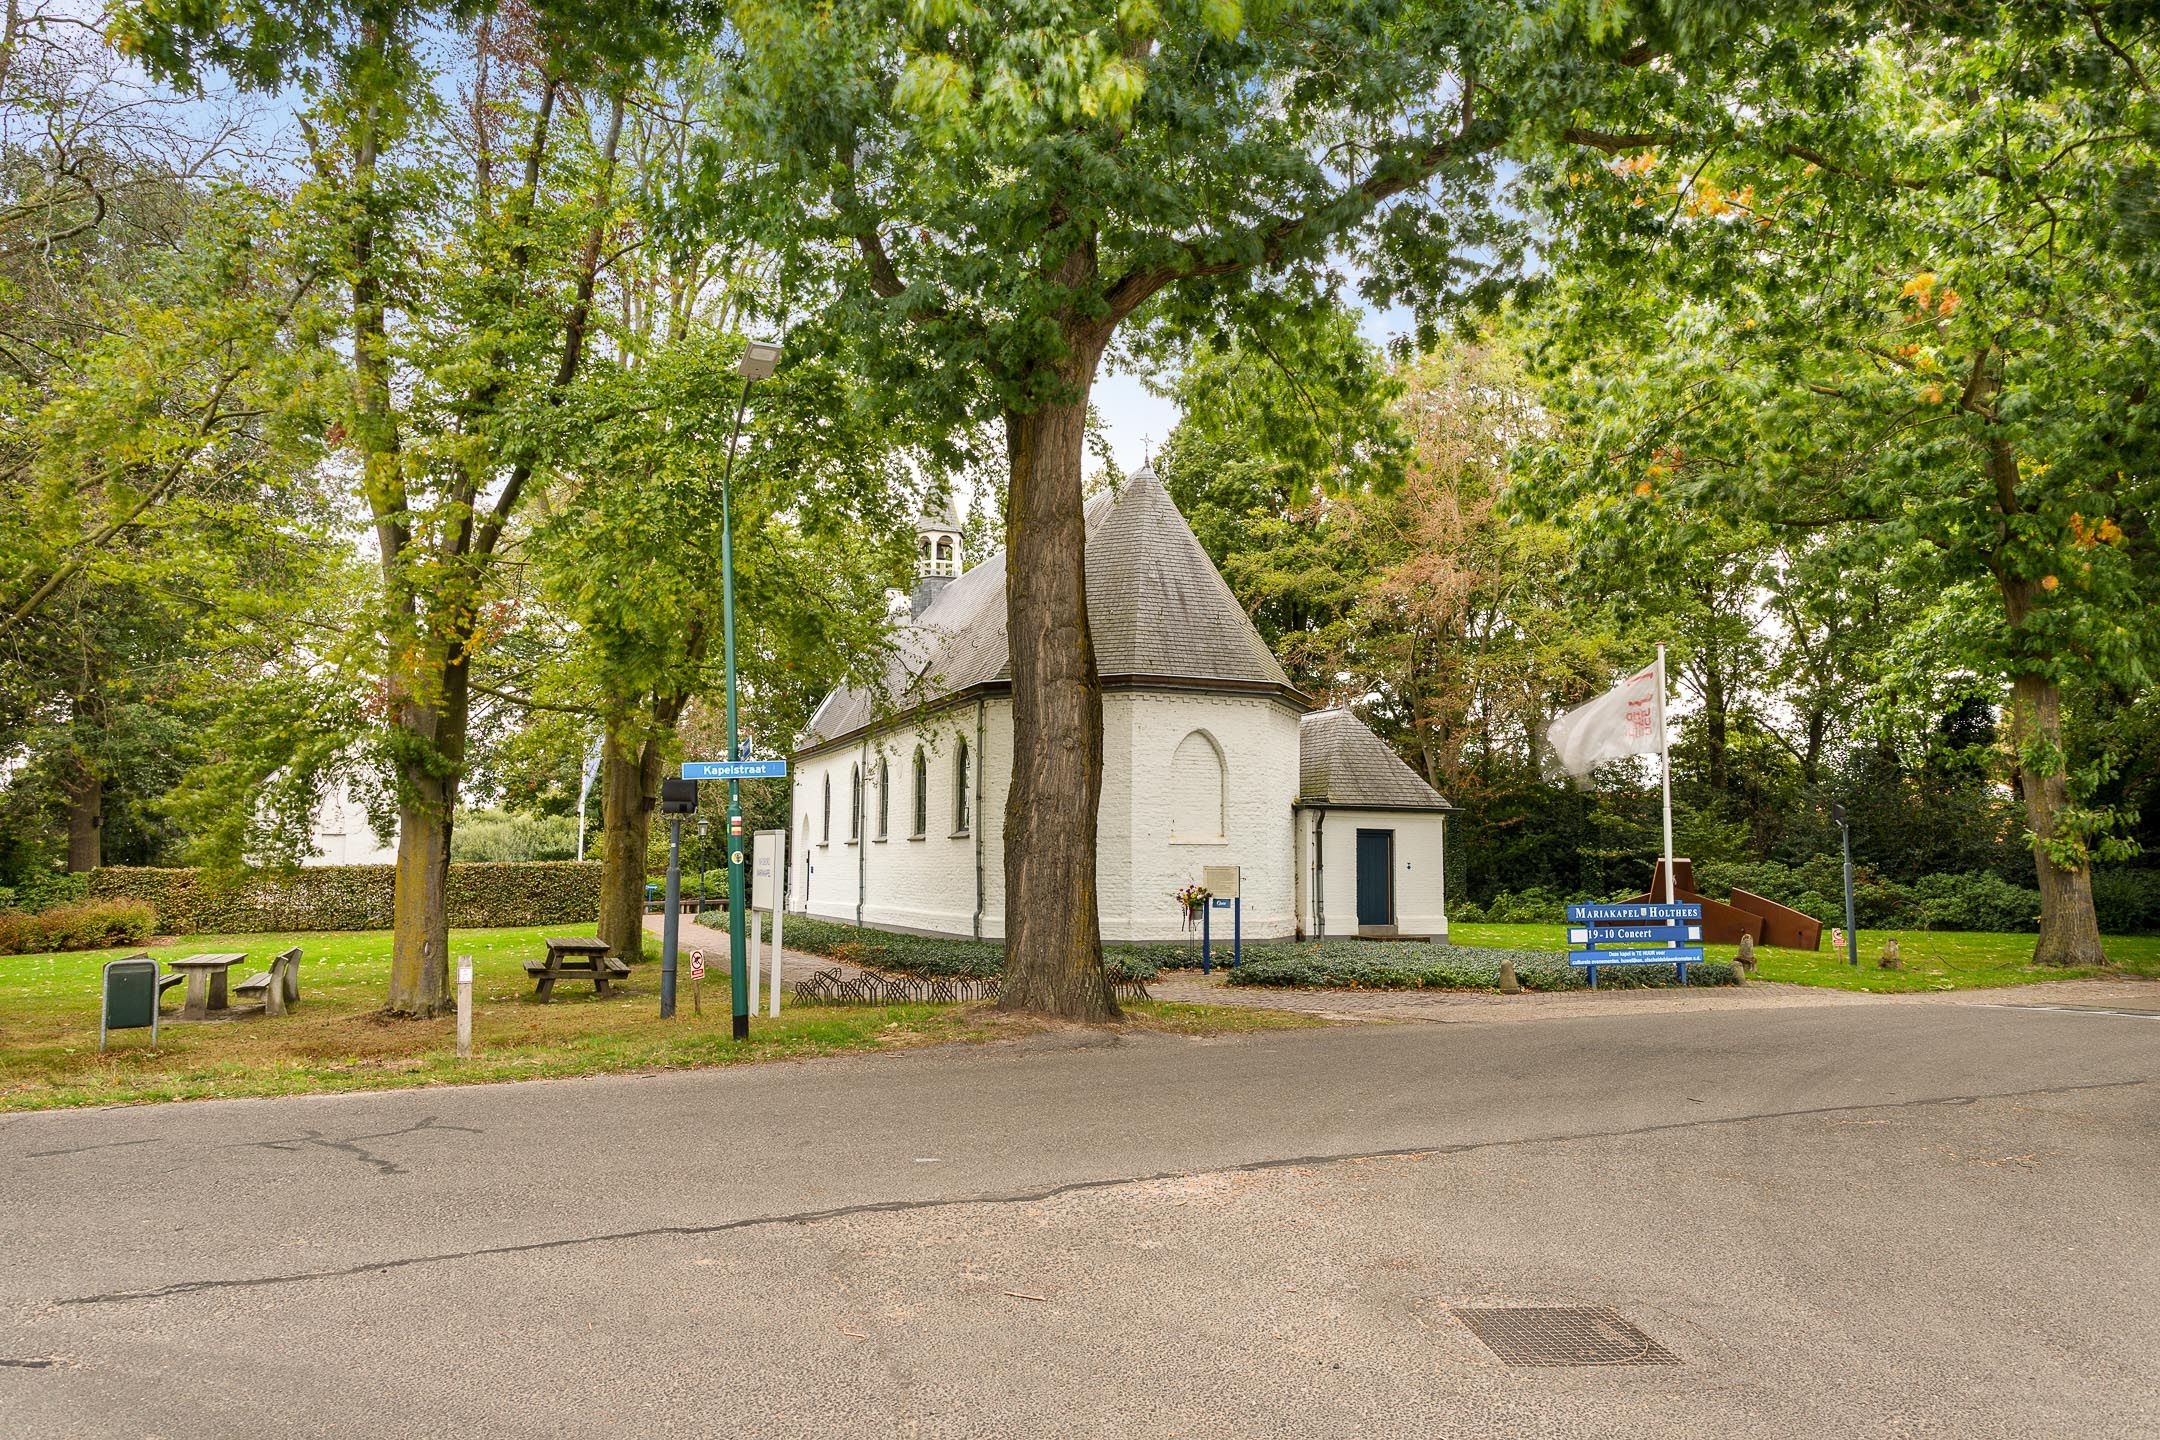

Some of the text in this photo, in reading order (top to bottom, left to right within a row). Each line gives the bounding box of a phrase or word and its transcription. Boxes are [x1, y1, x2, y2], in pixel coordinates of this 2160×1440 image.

[704, 764, 766, 776] Kapelstraat
[1576, 907, 1698, 918] MARIAKAPEL HOLTHEES
[1618, 929, 1651, 938] Concert
